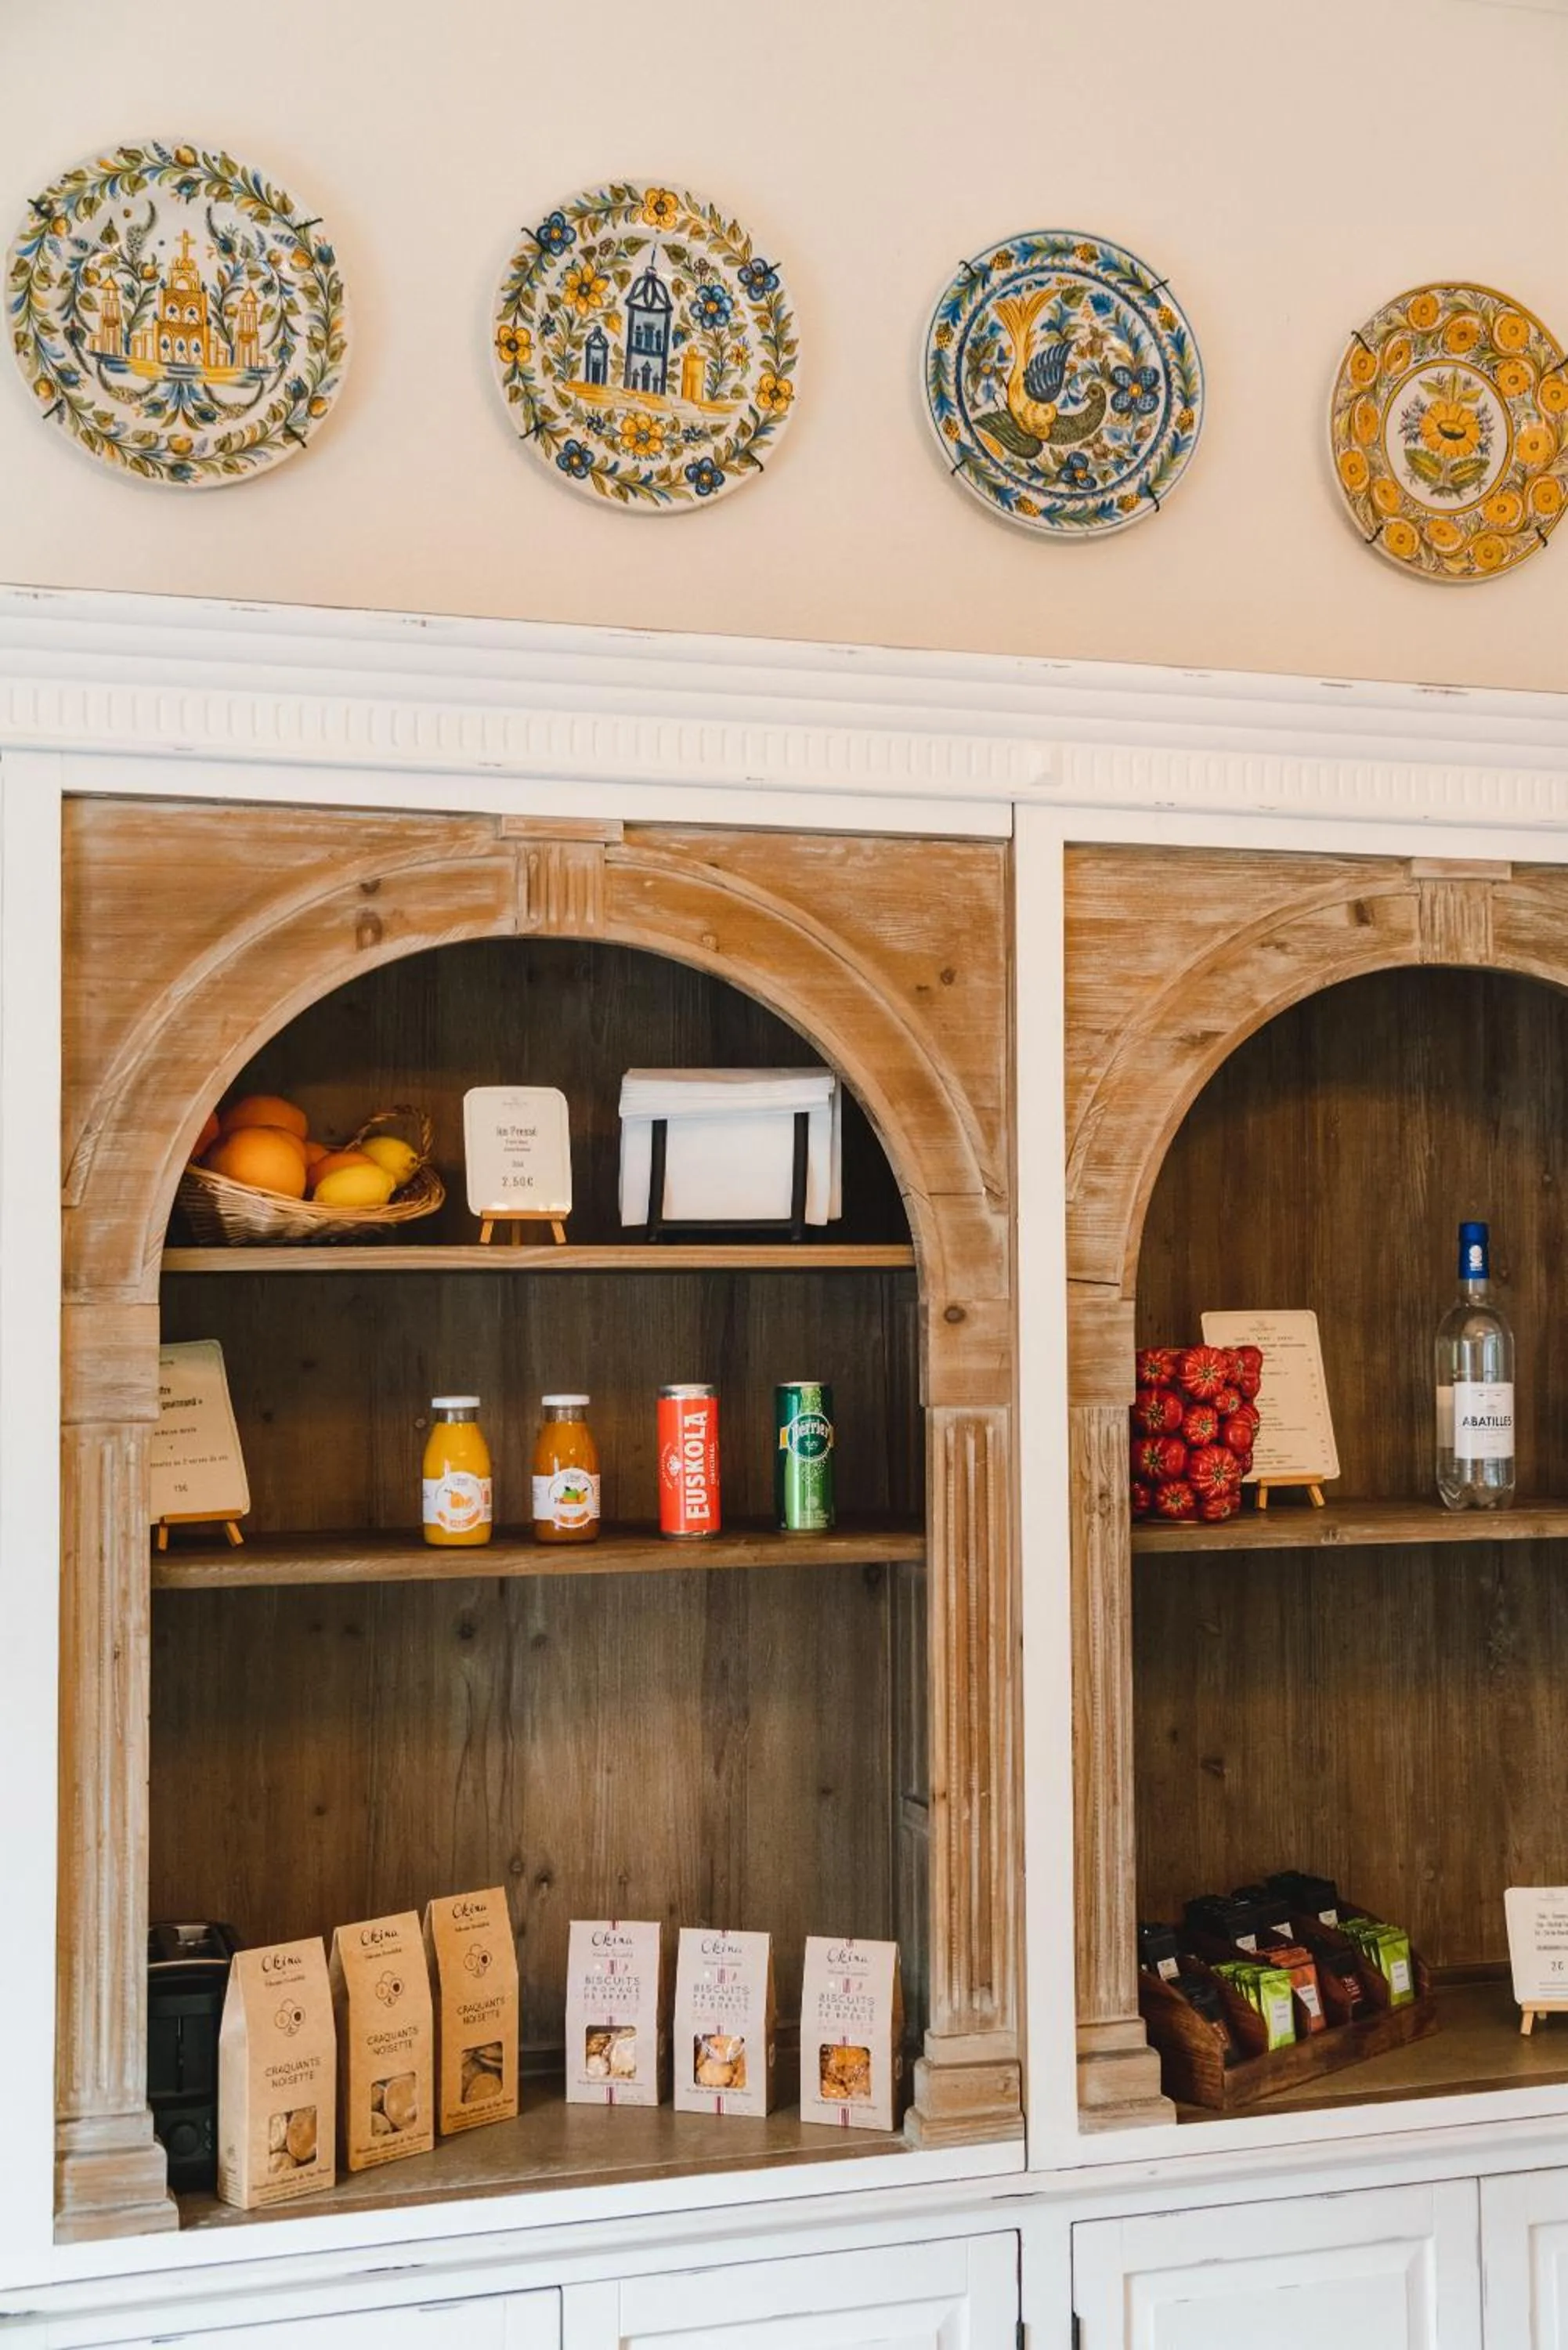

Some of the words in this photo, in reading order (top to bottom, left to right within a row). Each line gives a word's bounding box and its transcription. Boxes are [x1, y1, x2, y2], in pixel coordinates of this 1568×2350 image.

[1462, 1415, 1512, 1426] ABATILLES
[684, 1410, 711, 1519] EUSKOLA
[584, 1975, 640, 1985] BISCUITS
[693, 1983, 750, 1995] BISCUITS
[818, 1994, 876, 2005] BISCUITS
[366, 2026, 419, 2046] CRAQUANTS
[265, 2055, 320, 2077] CRAQUANTS
[271, 2070, 314, 2088] NOISETTE
